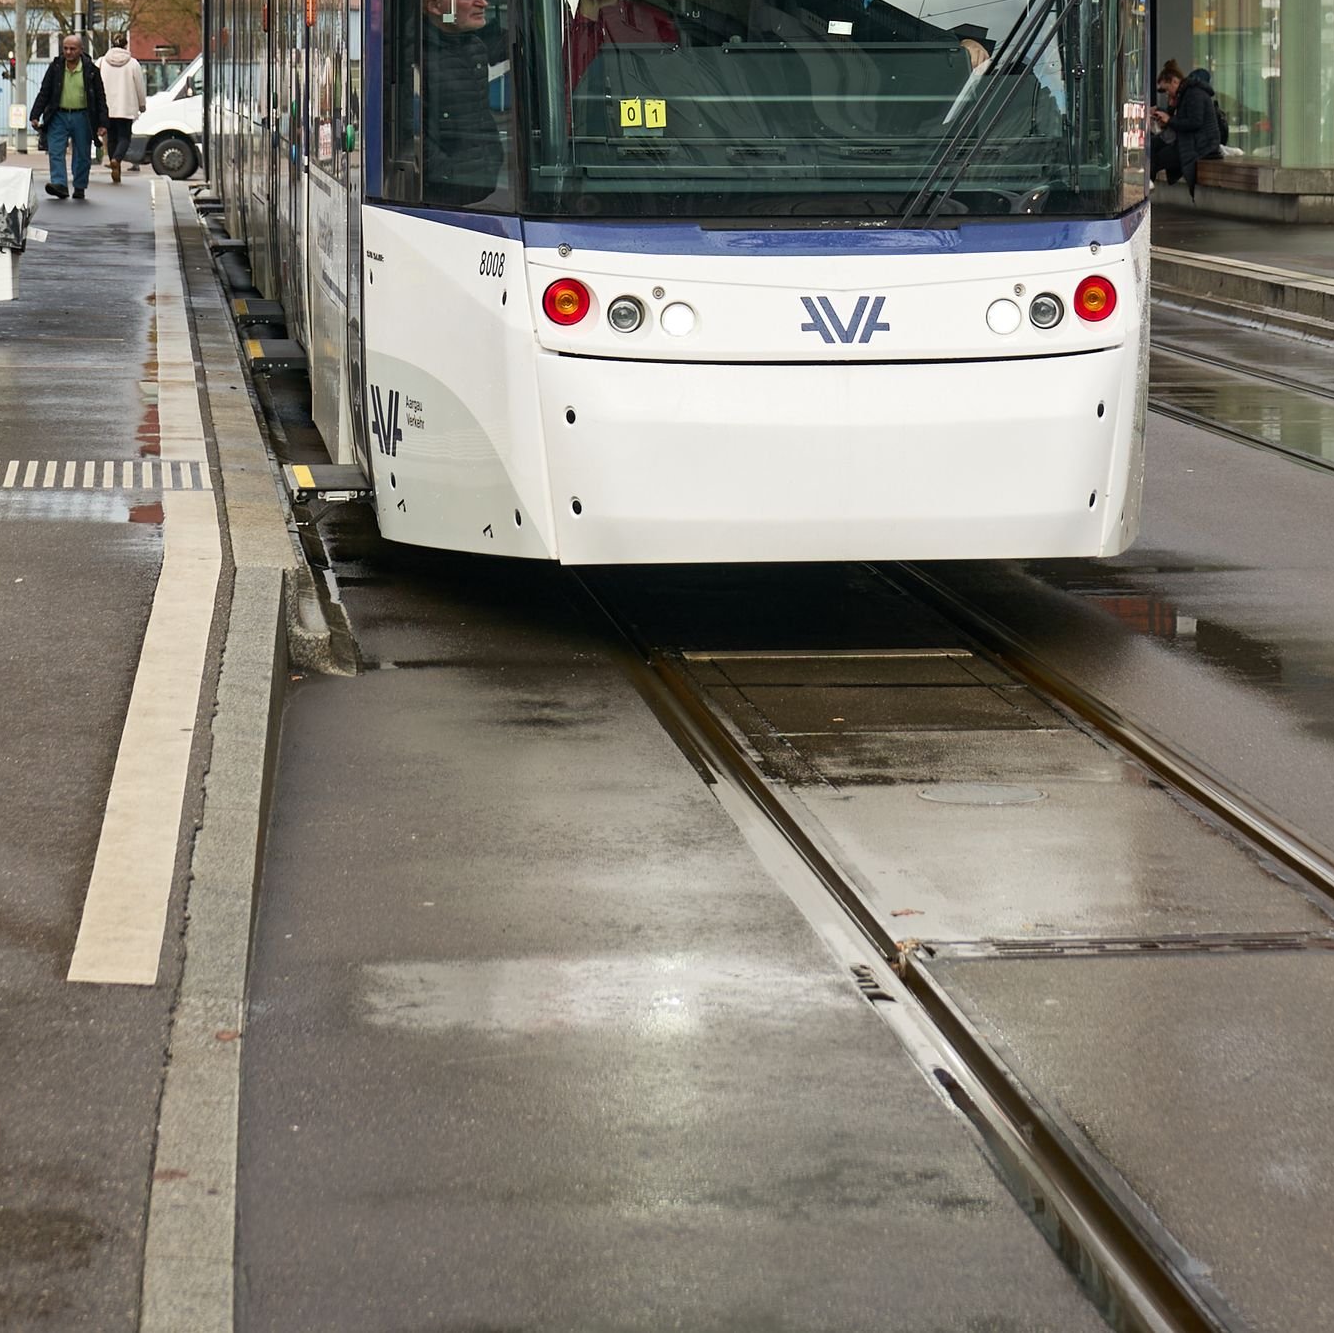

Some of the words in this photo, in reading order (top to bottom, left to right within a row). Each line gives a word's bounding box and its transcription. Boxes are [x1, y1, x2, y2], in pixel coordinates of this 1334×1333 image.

[479, 250, 506, 278] 8008
[406, 395, 423, 412] Aargau
[407, 413, 425, 429] Verkehr
